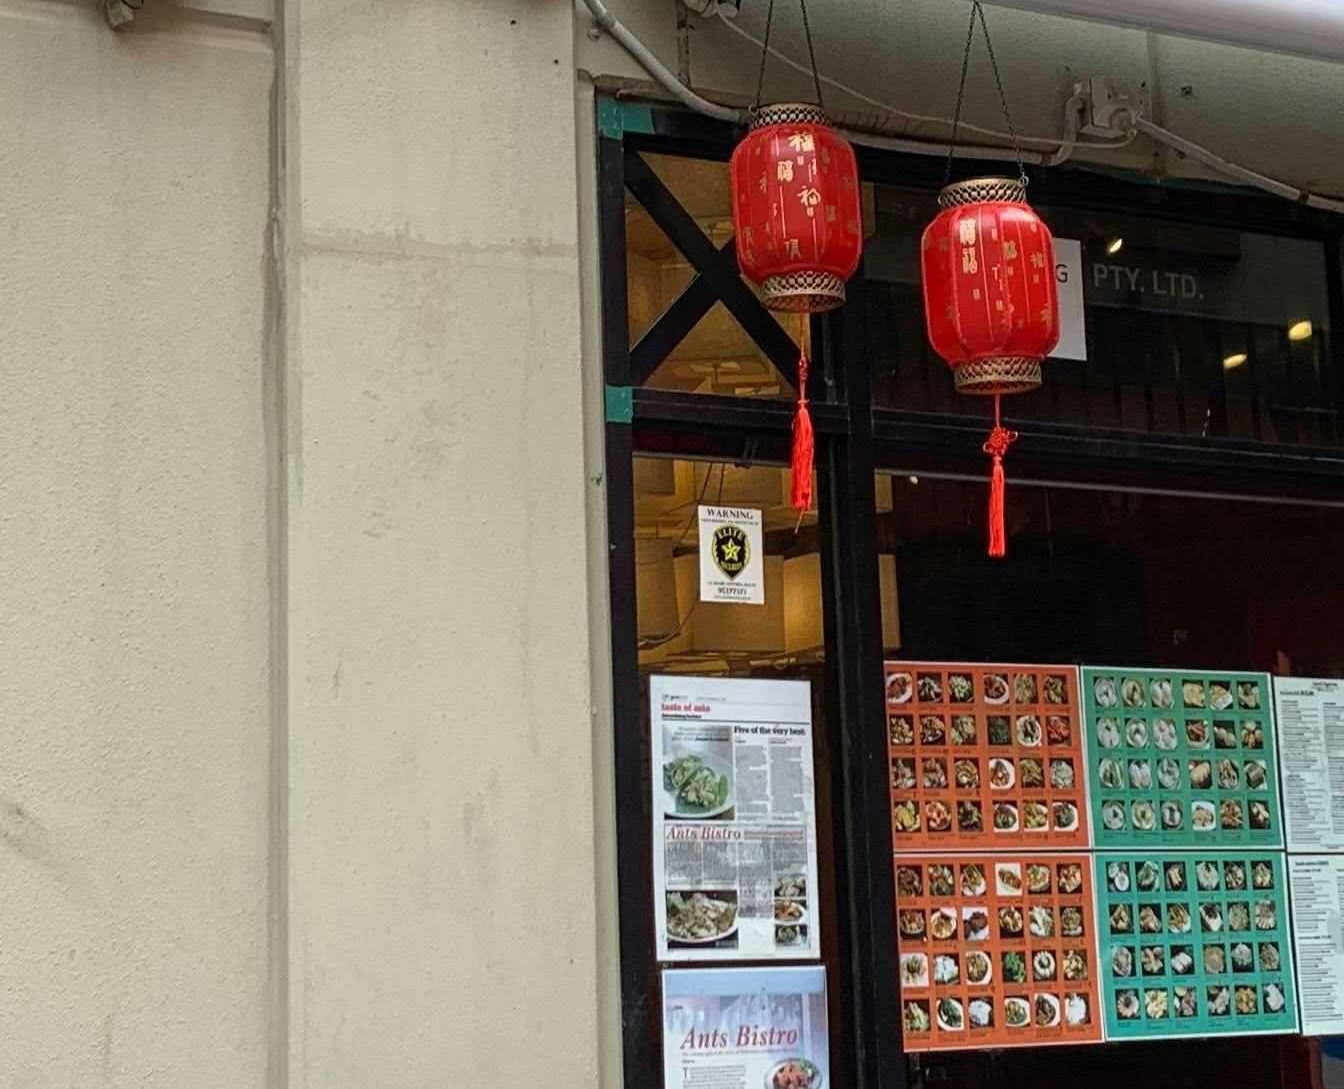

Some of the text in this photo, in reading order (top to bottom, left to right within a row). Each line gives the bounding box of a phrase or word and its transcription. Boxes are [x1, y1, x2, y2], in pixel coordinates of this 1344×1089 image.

[1093, 263, 1205, 300] PTY. LTD.
[707, 508, 753, 519] WARNING
[717, 526, 745, 540] ELITE
[734, 726, 749, 734] Five
[751, 726, 758, 734] of
[759, 726, 771, 734] the
[772, 728, 789, 736] very
[666, 827, 697, 840] Ants
[701, 826, 742, 840] Bistro
[680, 1024, 797, 1050] Ants Bistro
